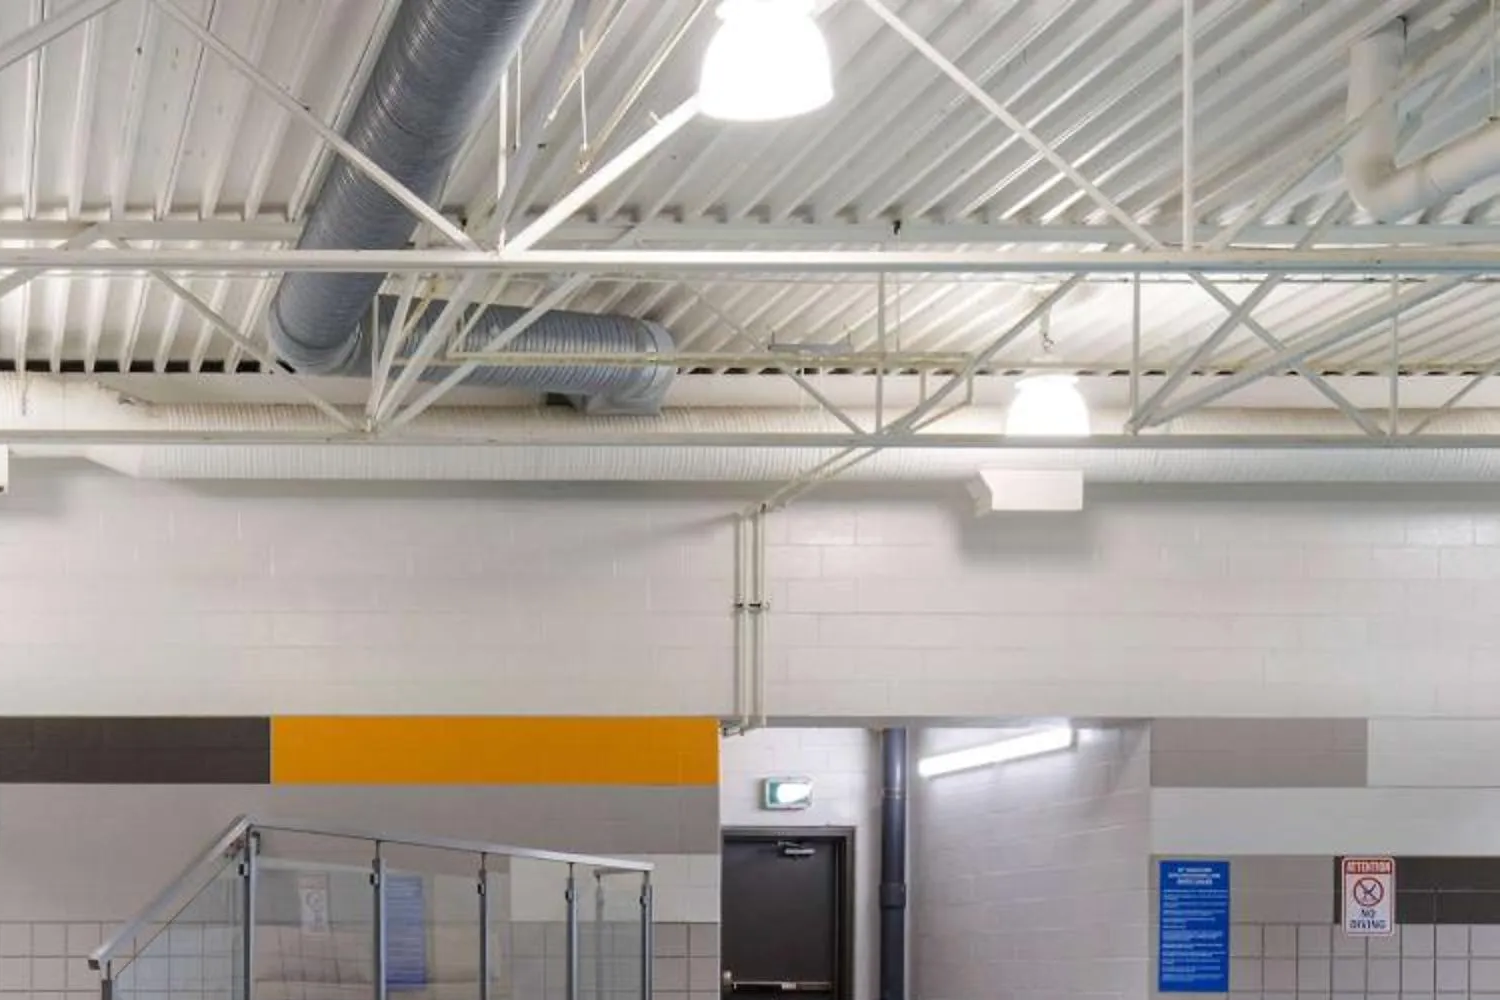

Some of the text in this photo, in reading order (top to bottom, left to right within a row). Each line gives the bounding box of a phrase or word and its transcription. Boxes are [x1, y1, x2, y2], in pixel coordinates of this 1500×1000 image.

[1346, 861, 1391, 873] ATTENTION
[1361, 909, 1376, 918] NO
[1349, 919, 1387, 929] DIVING
